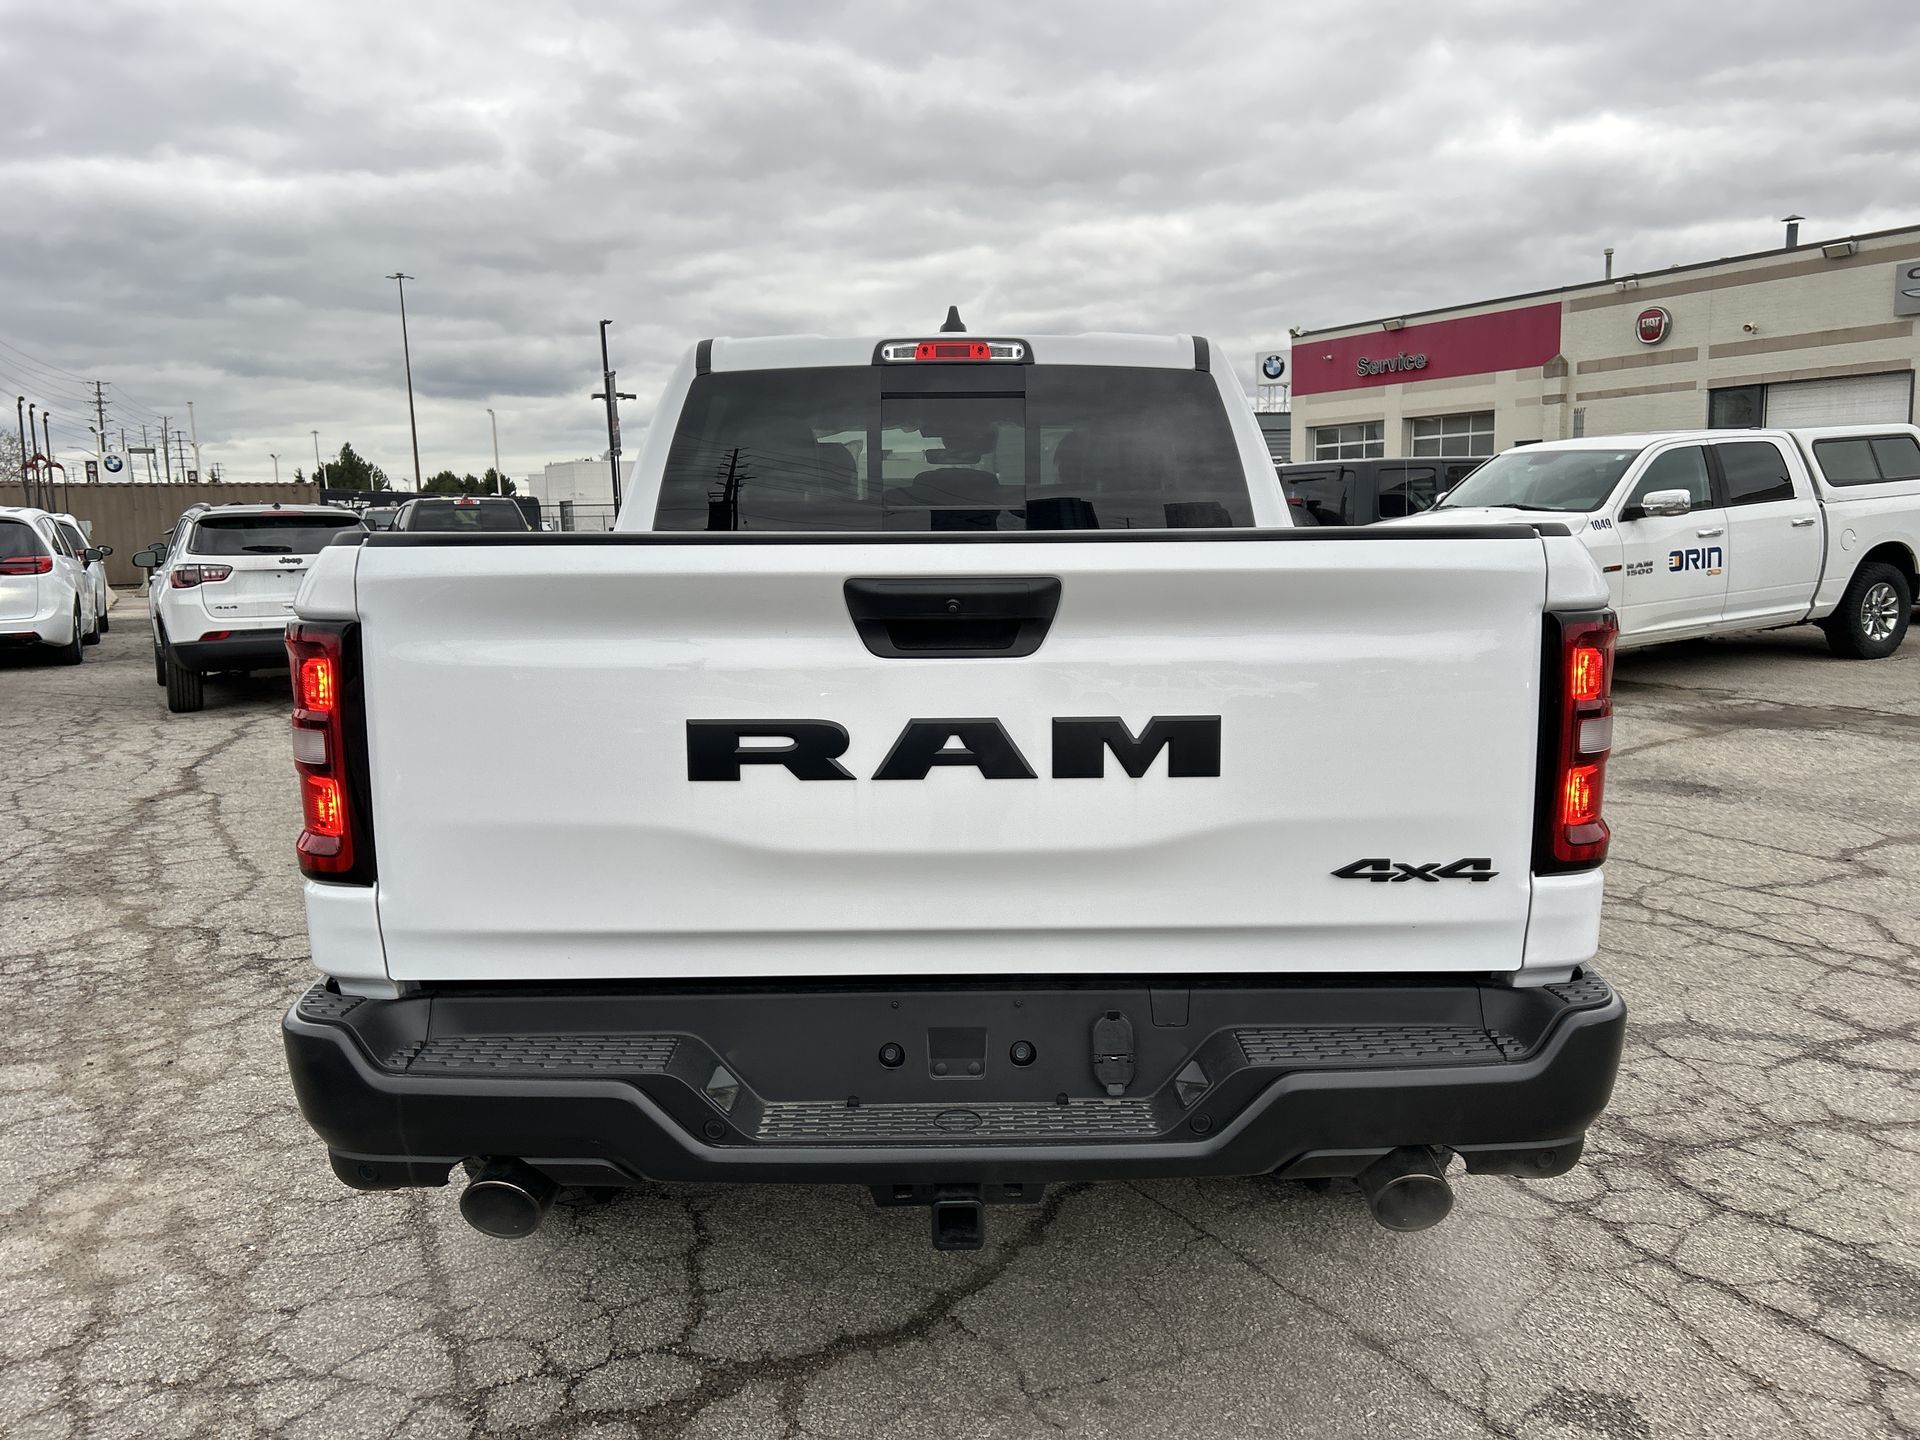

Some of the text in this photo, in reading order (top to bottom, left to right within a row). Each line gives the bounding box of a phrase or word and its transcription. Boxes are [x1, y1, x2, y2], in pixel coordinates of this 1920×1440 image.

[1356, 352, 1427, 377] Service
[1590, 518, 1613, 531] 1049
[279, 556, 303, 564] Jeep
[1626, 560, 1653, 569] RAM
[1626, 567, 1653, 576] 1500
[686, 715, 1222, 782] RAM
[1330, 857, 1501, 883] 4x4
